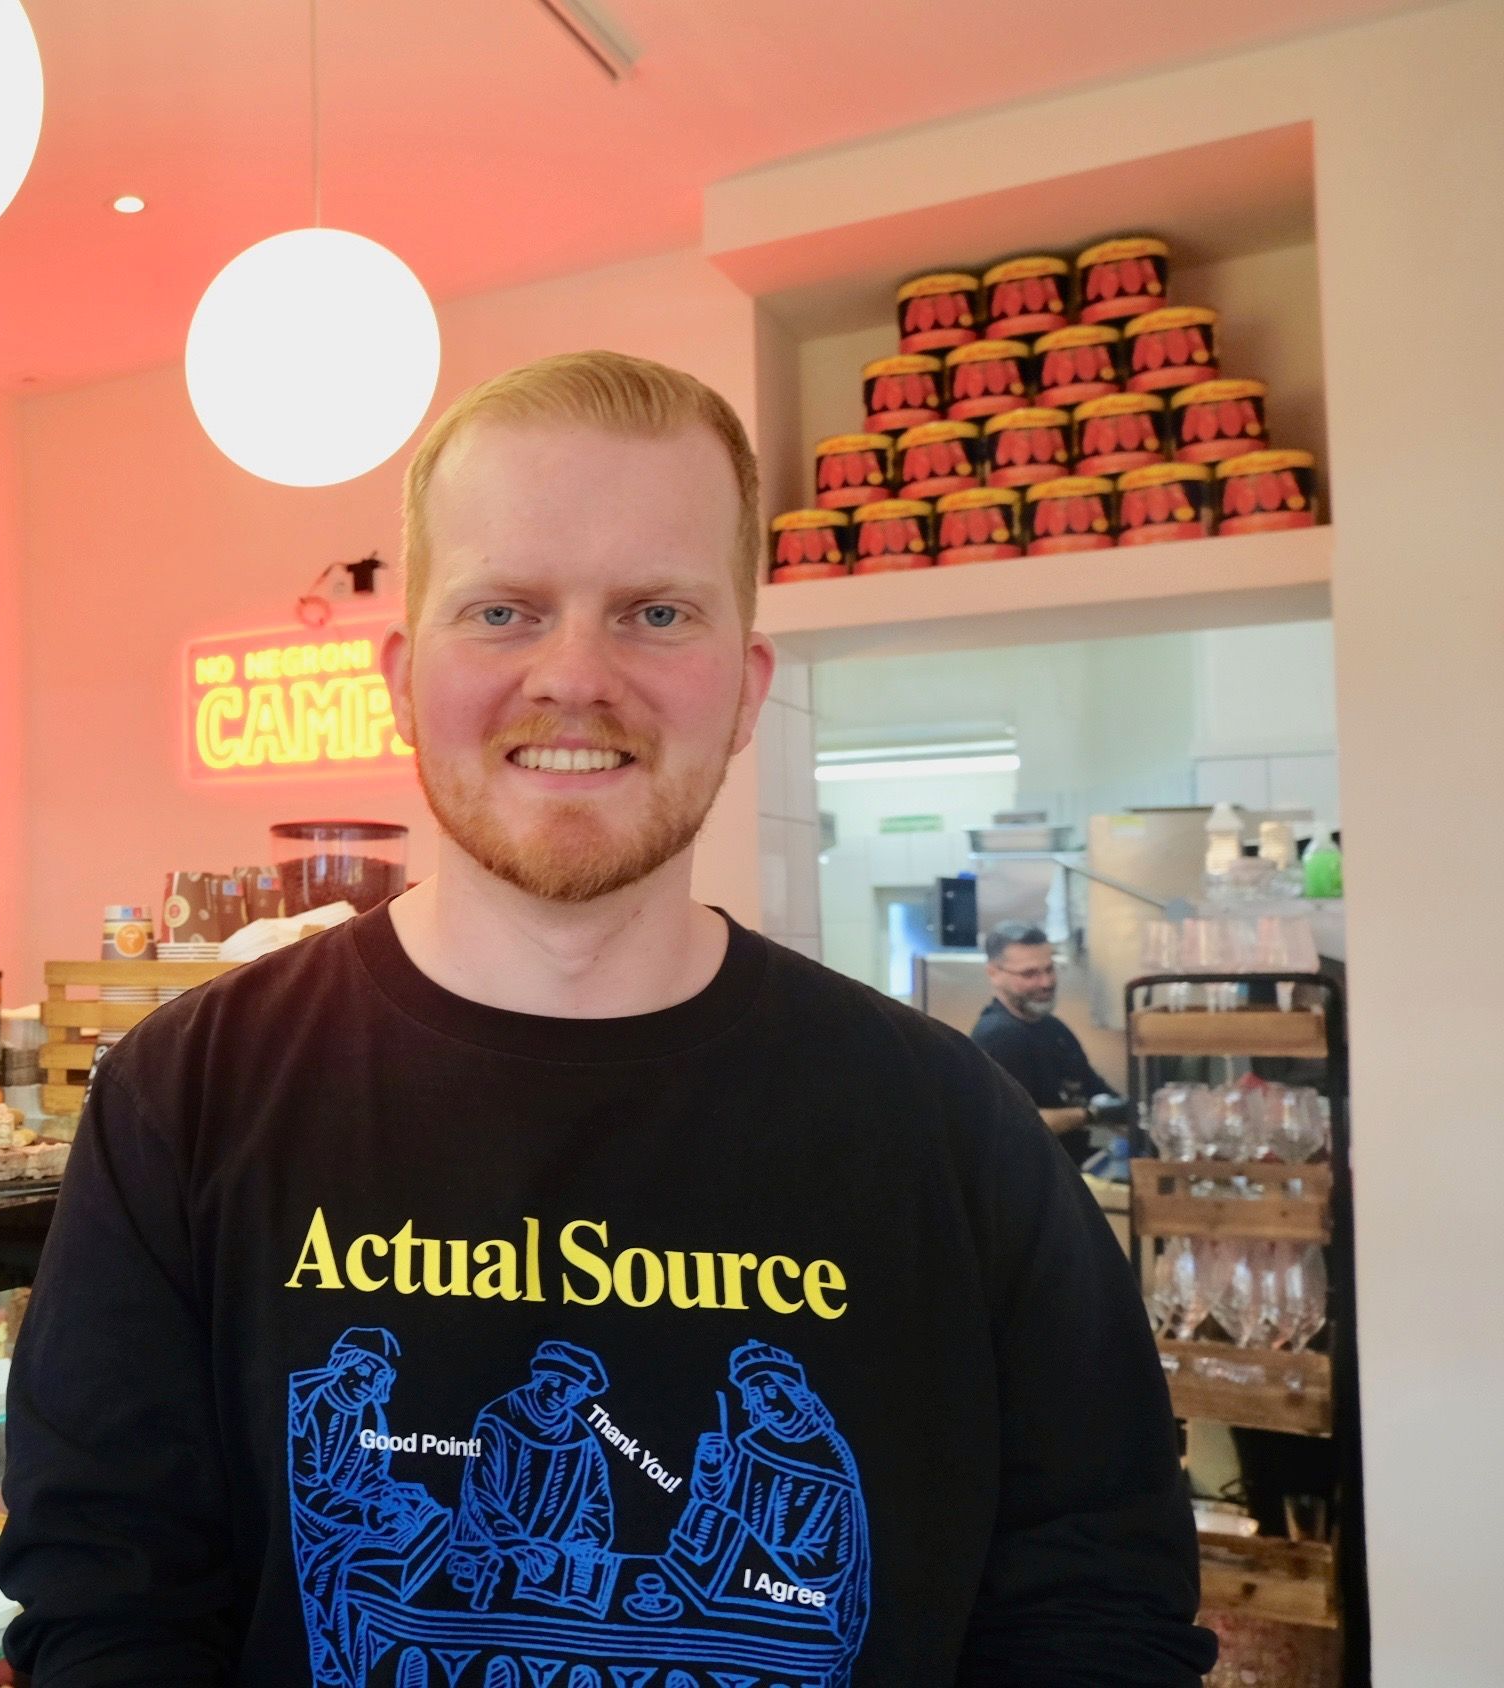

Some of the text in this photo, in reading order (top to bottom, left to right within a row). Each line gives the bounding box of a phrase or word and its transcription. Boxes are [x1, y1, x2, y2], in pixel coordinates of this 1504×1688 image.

[196, 639, 372, 685] NO NEGRONI
[284, 1207, 849, 1320] Actual Source
[359, 1428, 483, 1458] Good Point!
[585, 1403, 683, 1494] Thank You!
[743, 1568, 827, 1608] I Agree
